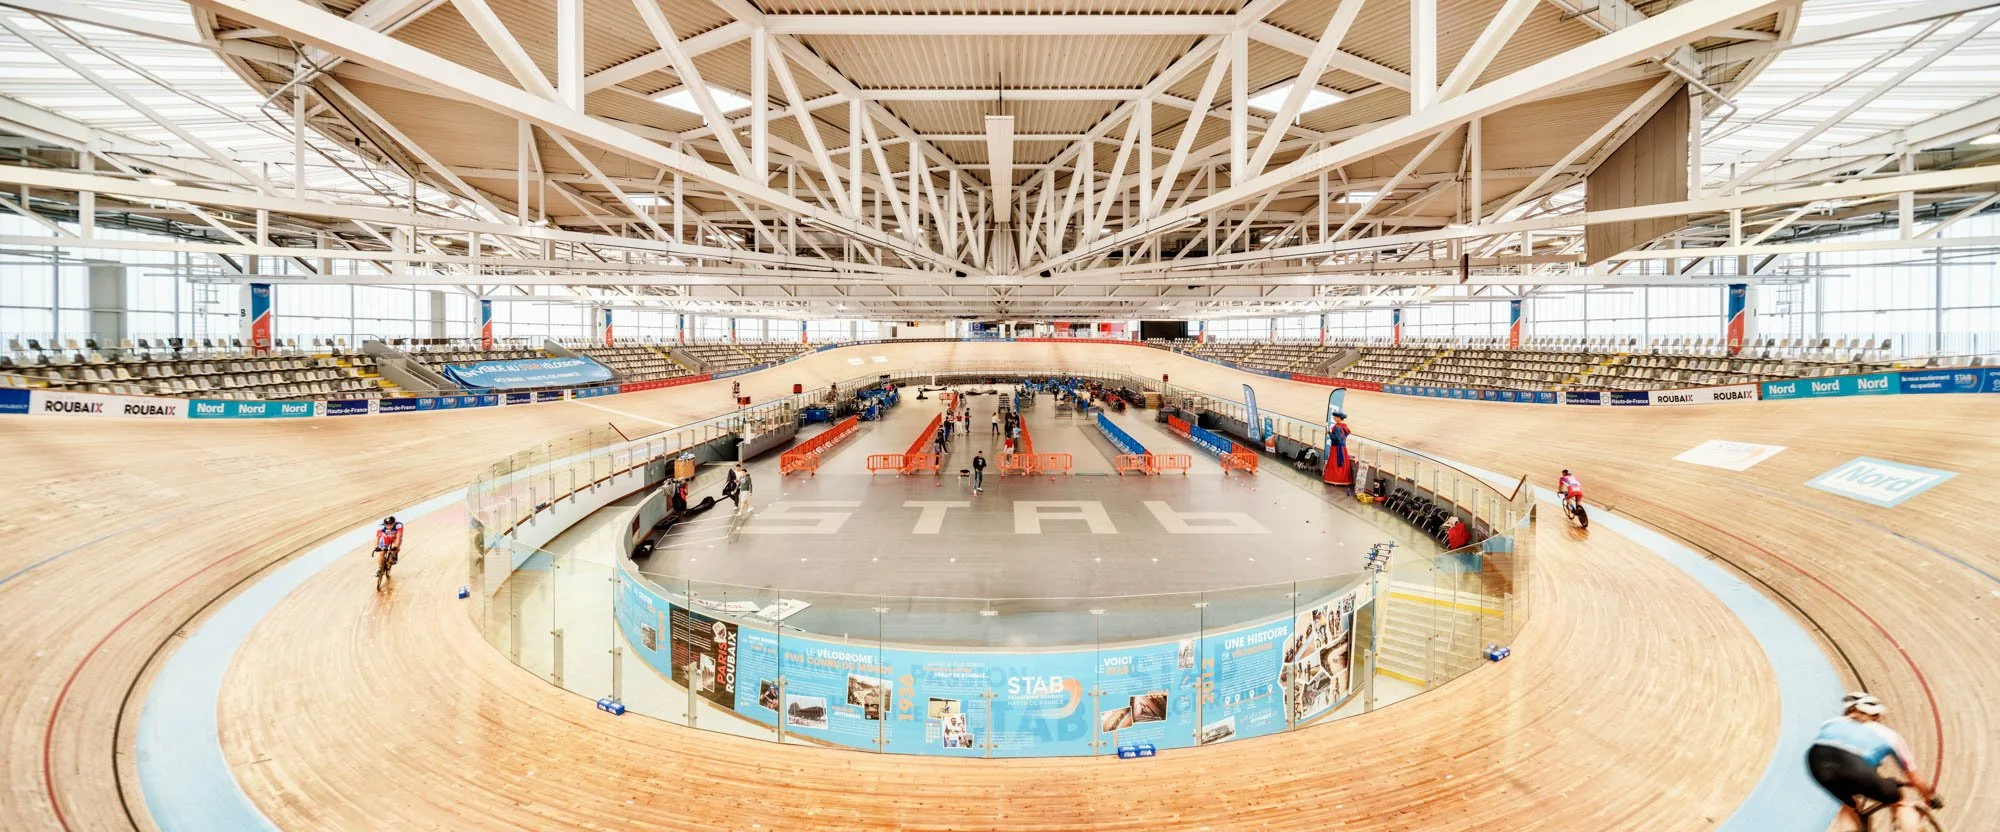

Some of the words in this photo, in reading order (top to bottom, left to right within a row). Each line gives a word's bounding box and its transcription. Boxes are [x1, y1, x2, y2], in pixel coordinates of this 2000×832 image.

[1768, 383, 1795, 394] Nord
[1811, 380, 1839, 391] Nord
[1857, 376, 1888, 389] Nord
[1657, 394, 1693, 403] ROUBAIX
[1713, 391, 1752, 400] ROUBAIX
[45, 401, 103, 413] ROUBAIX
[124, 404, 175, 416] ROUBAIX
[197, 402, 224, 413] Nord
[238, 403, 265, 413] Nord
[281, 403, 307, 413] Nord
[1836, 466, 1924, 492] Nord
[1224, 636, 1245, 650] UNE
[1247, 625, 1288, 646] HISTOIRE
[806, 647, 816, 656] LE
[817, 646, 873, 664] VÉLODROME
[1104, 656, 1132, 666] VOICI
[717, 642, 727, 684] PARIS
[726, 631, 737, 693] ROUBAIX
[1007, 675, 1064, 694] STAB
[1201, 656, 1215, 704] 2012
[898, 674, 915, 721] 1936
